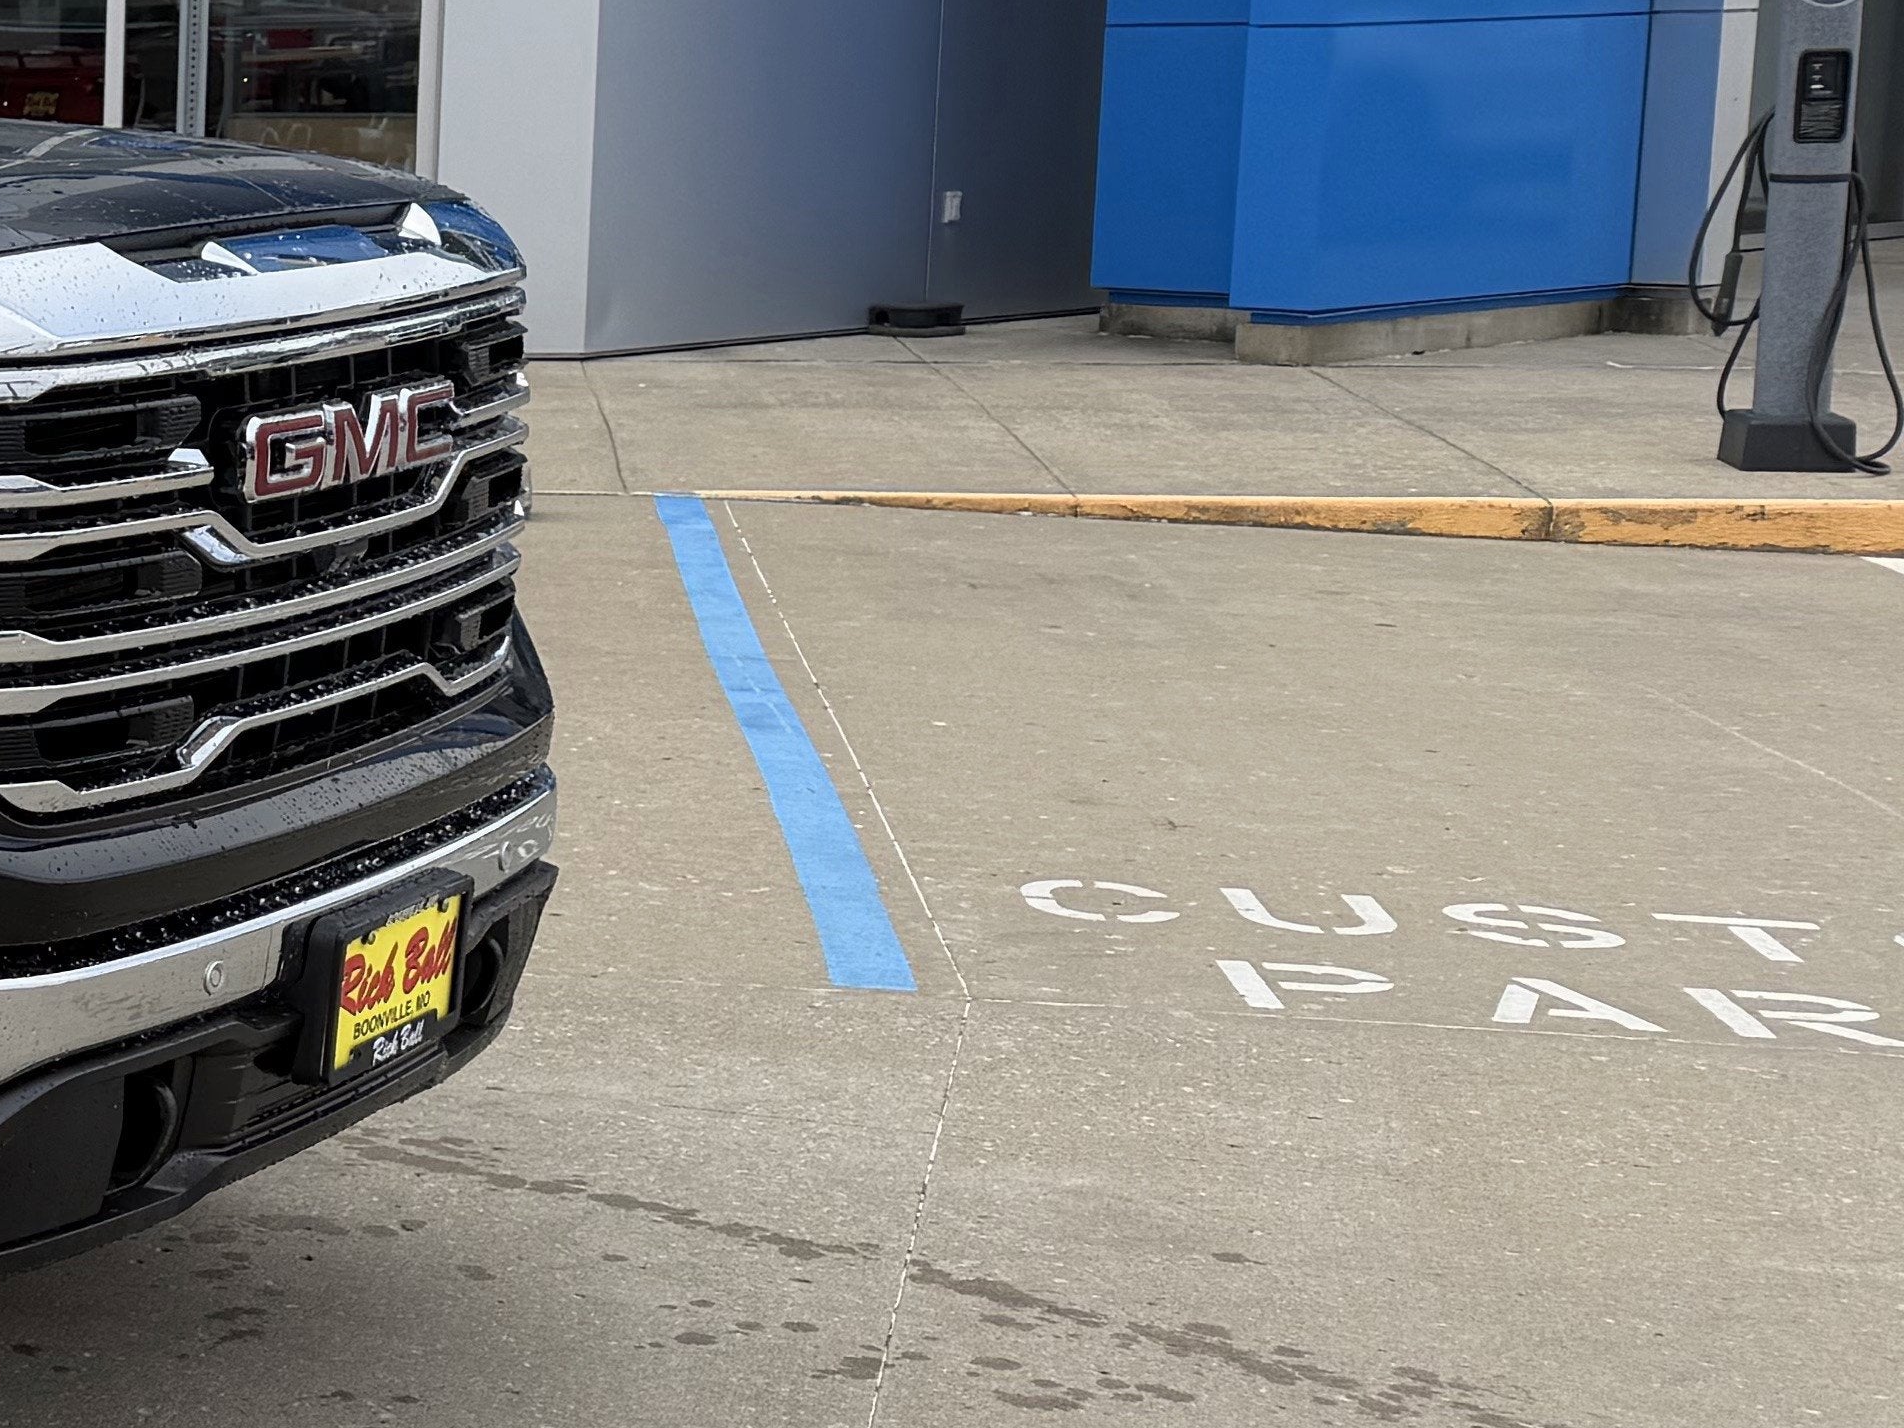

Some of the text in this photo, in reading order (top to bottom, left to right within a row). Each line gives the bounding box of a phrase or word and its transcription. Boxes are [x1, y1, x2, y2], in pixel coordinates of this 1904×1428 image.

[243, 379, 454, 503] GMC
[340, 918, 457, 1015] Rick Ball
[1019, 879, 1904, 963] CUST
[1216, 959, 1904, 1047] PAR
